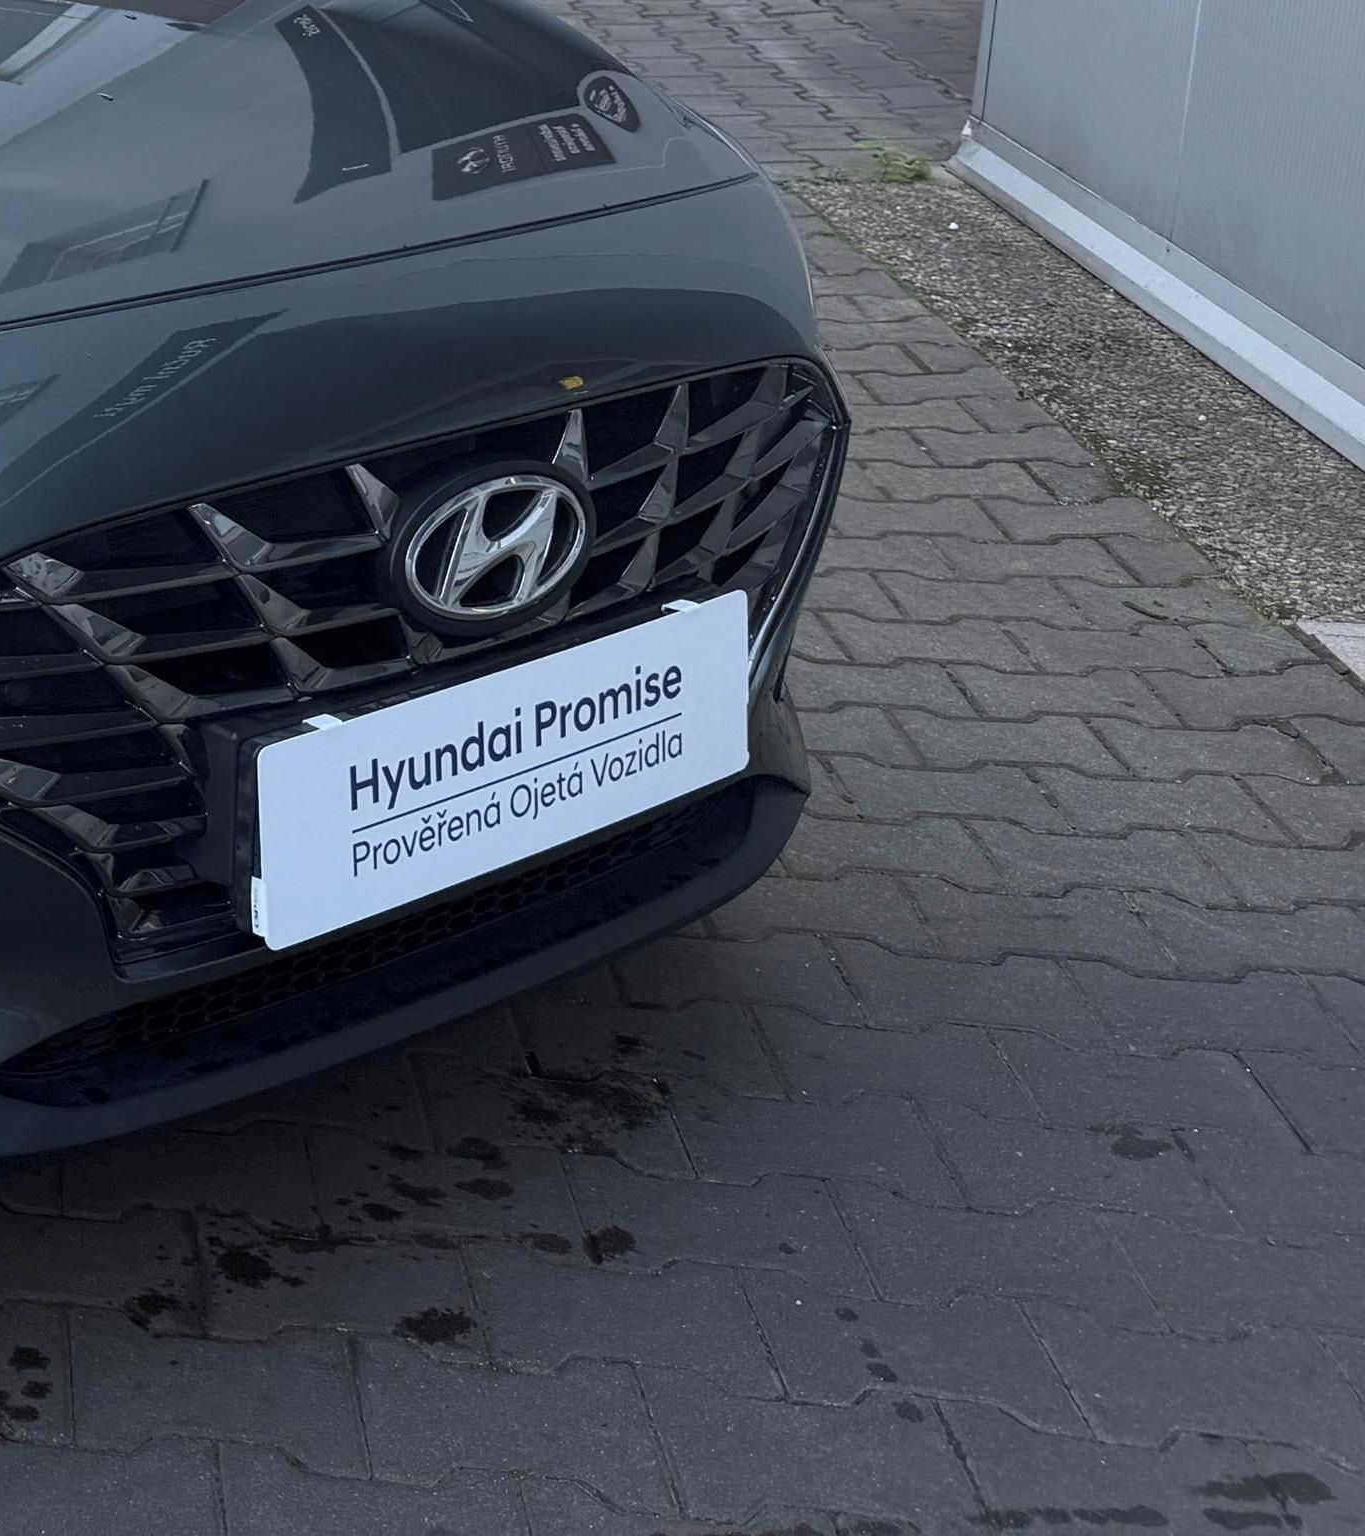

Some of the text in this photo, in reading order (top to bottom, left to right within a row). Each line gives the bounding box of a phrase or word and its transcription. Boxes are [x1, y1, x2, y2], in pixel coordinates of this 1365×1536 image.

[349, 663, 683, 812] Hyundai Promise
[351, 728, 684, 878] Prověřená Ojetá Vozidla
